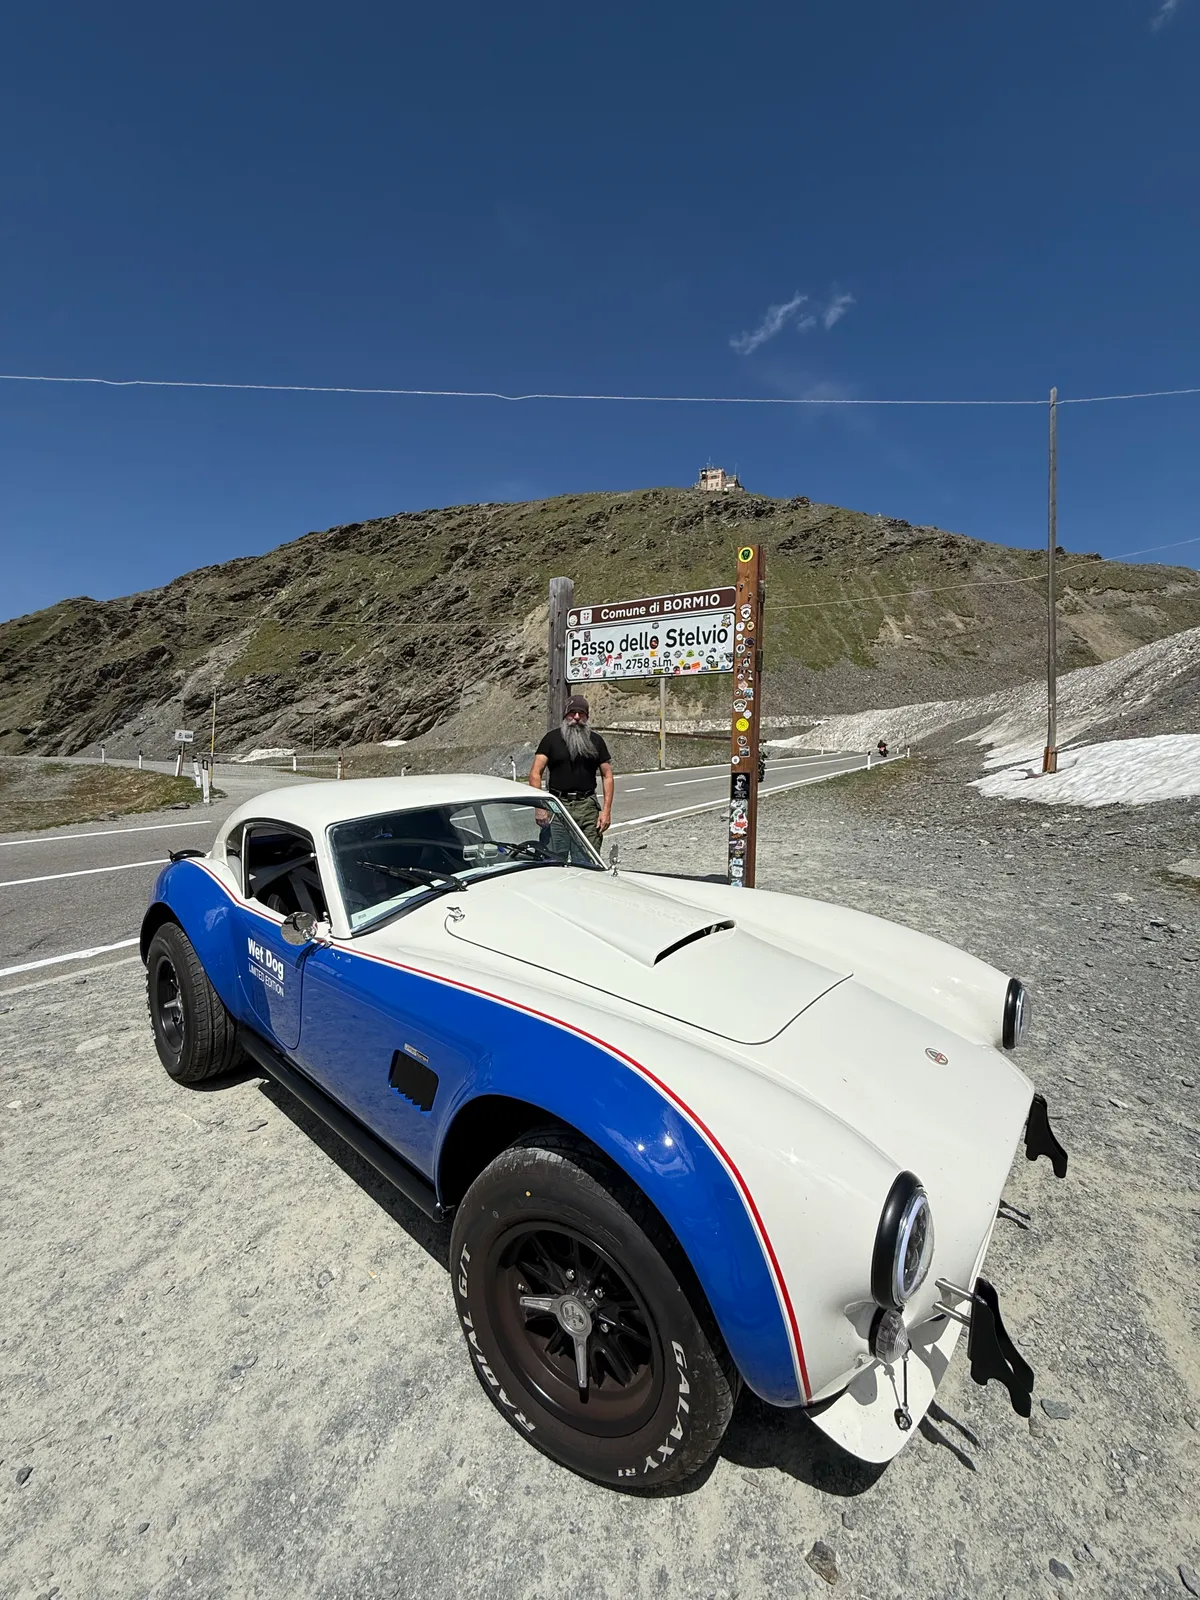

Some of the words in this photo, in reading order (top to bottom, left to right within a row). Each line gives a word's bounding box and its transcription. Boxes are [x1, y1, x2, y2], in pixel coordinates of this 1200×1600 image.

[601, 604, 646, 620] Comune
[649, 599, 660, 614] di
[665, 594, 721, 612] BORMIO
[571, 639, 614, 656] Passo
[619, 631, 659, 652] dello
[665, 624, 728, 648] Stelvio
[613, 662, 624, 671] m.
[625, 657, 650, 670] 2758
[247, 937, 264, 963] Wet
[266, 949, 284, 981] Dog
[248, 962, 265, 983] LIMITED
[265, 975, 284, 998] EDITION
[458, 1243, 471, 1299] G/T
[463, 1311, 537, 1433] RADIAL
[643, 1340, 690, 1474] GALAXY
